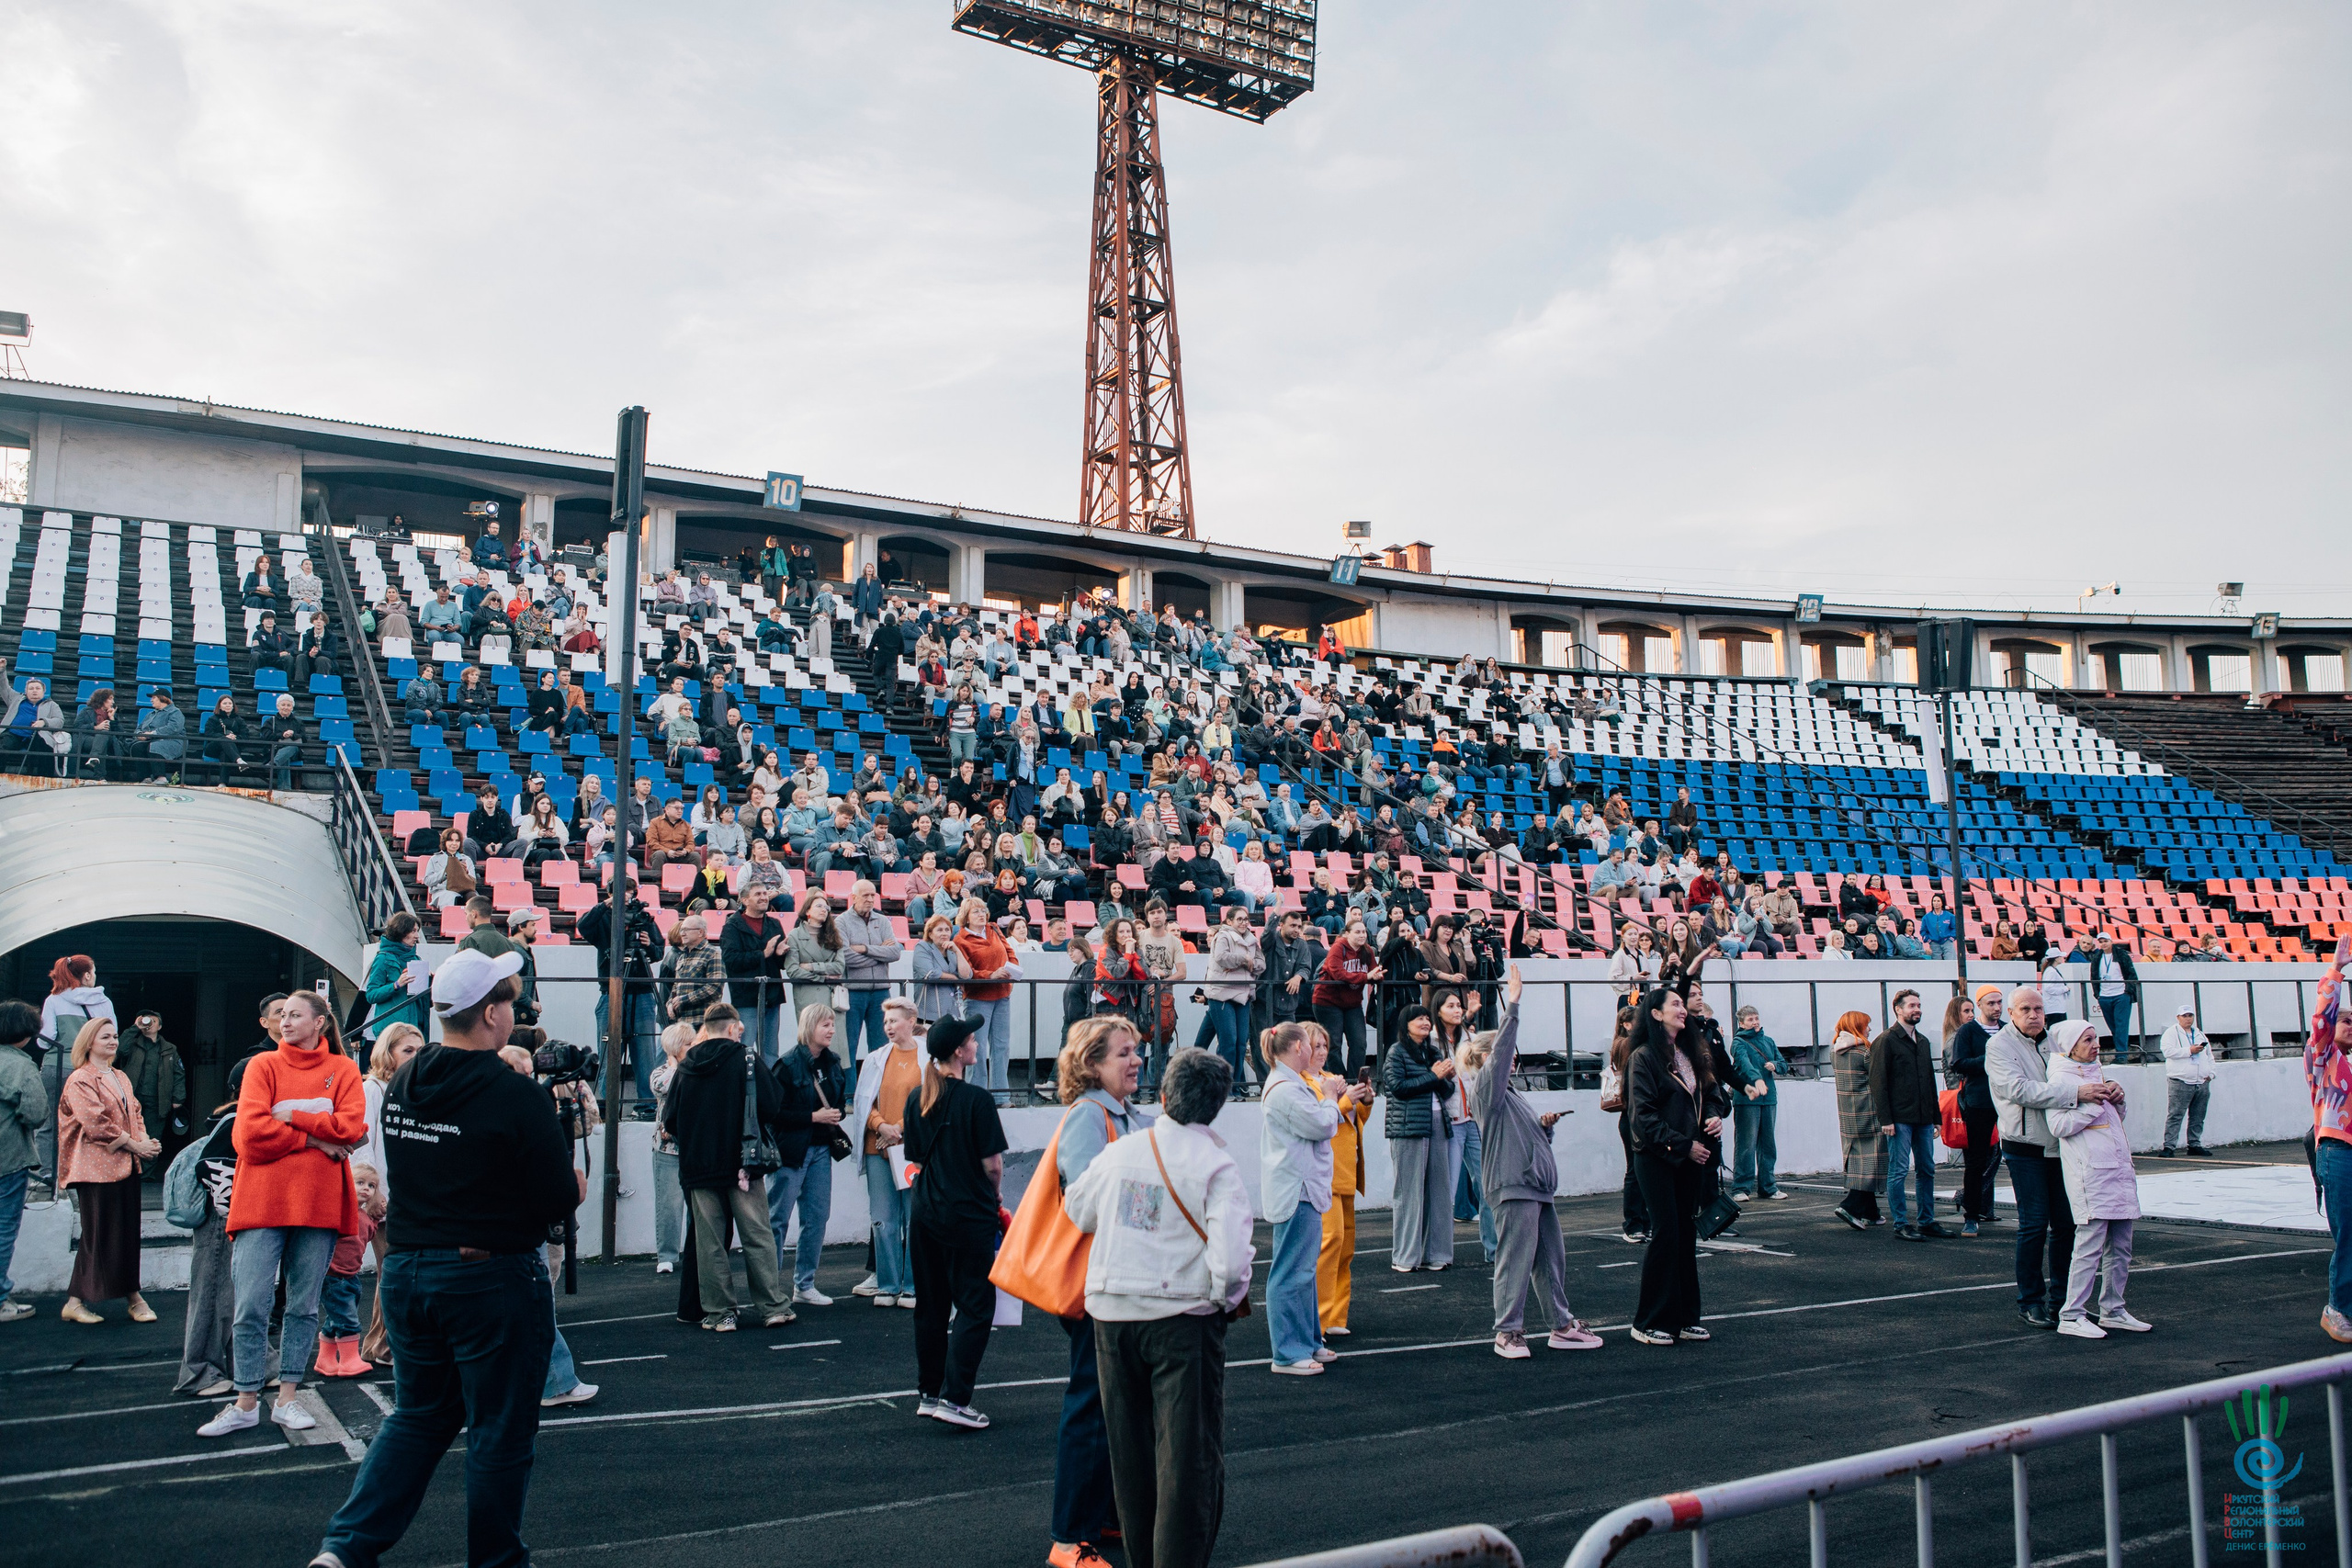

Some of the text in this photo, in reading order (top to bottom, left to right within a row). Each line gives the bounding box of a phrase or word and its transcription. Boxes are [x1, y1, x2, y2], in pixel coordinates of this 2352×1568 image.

[771, 478, 797, 505] 10
[1801, 598, 1818, 618] 12
[385, 1127, 440, 1144] мы разные
[402, 1118, 415, 1127] их
[418, 1122, 461, 1135] родаю,
